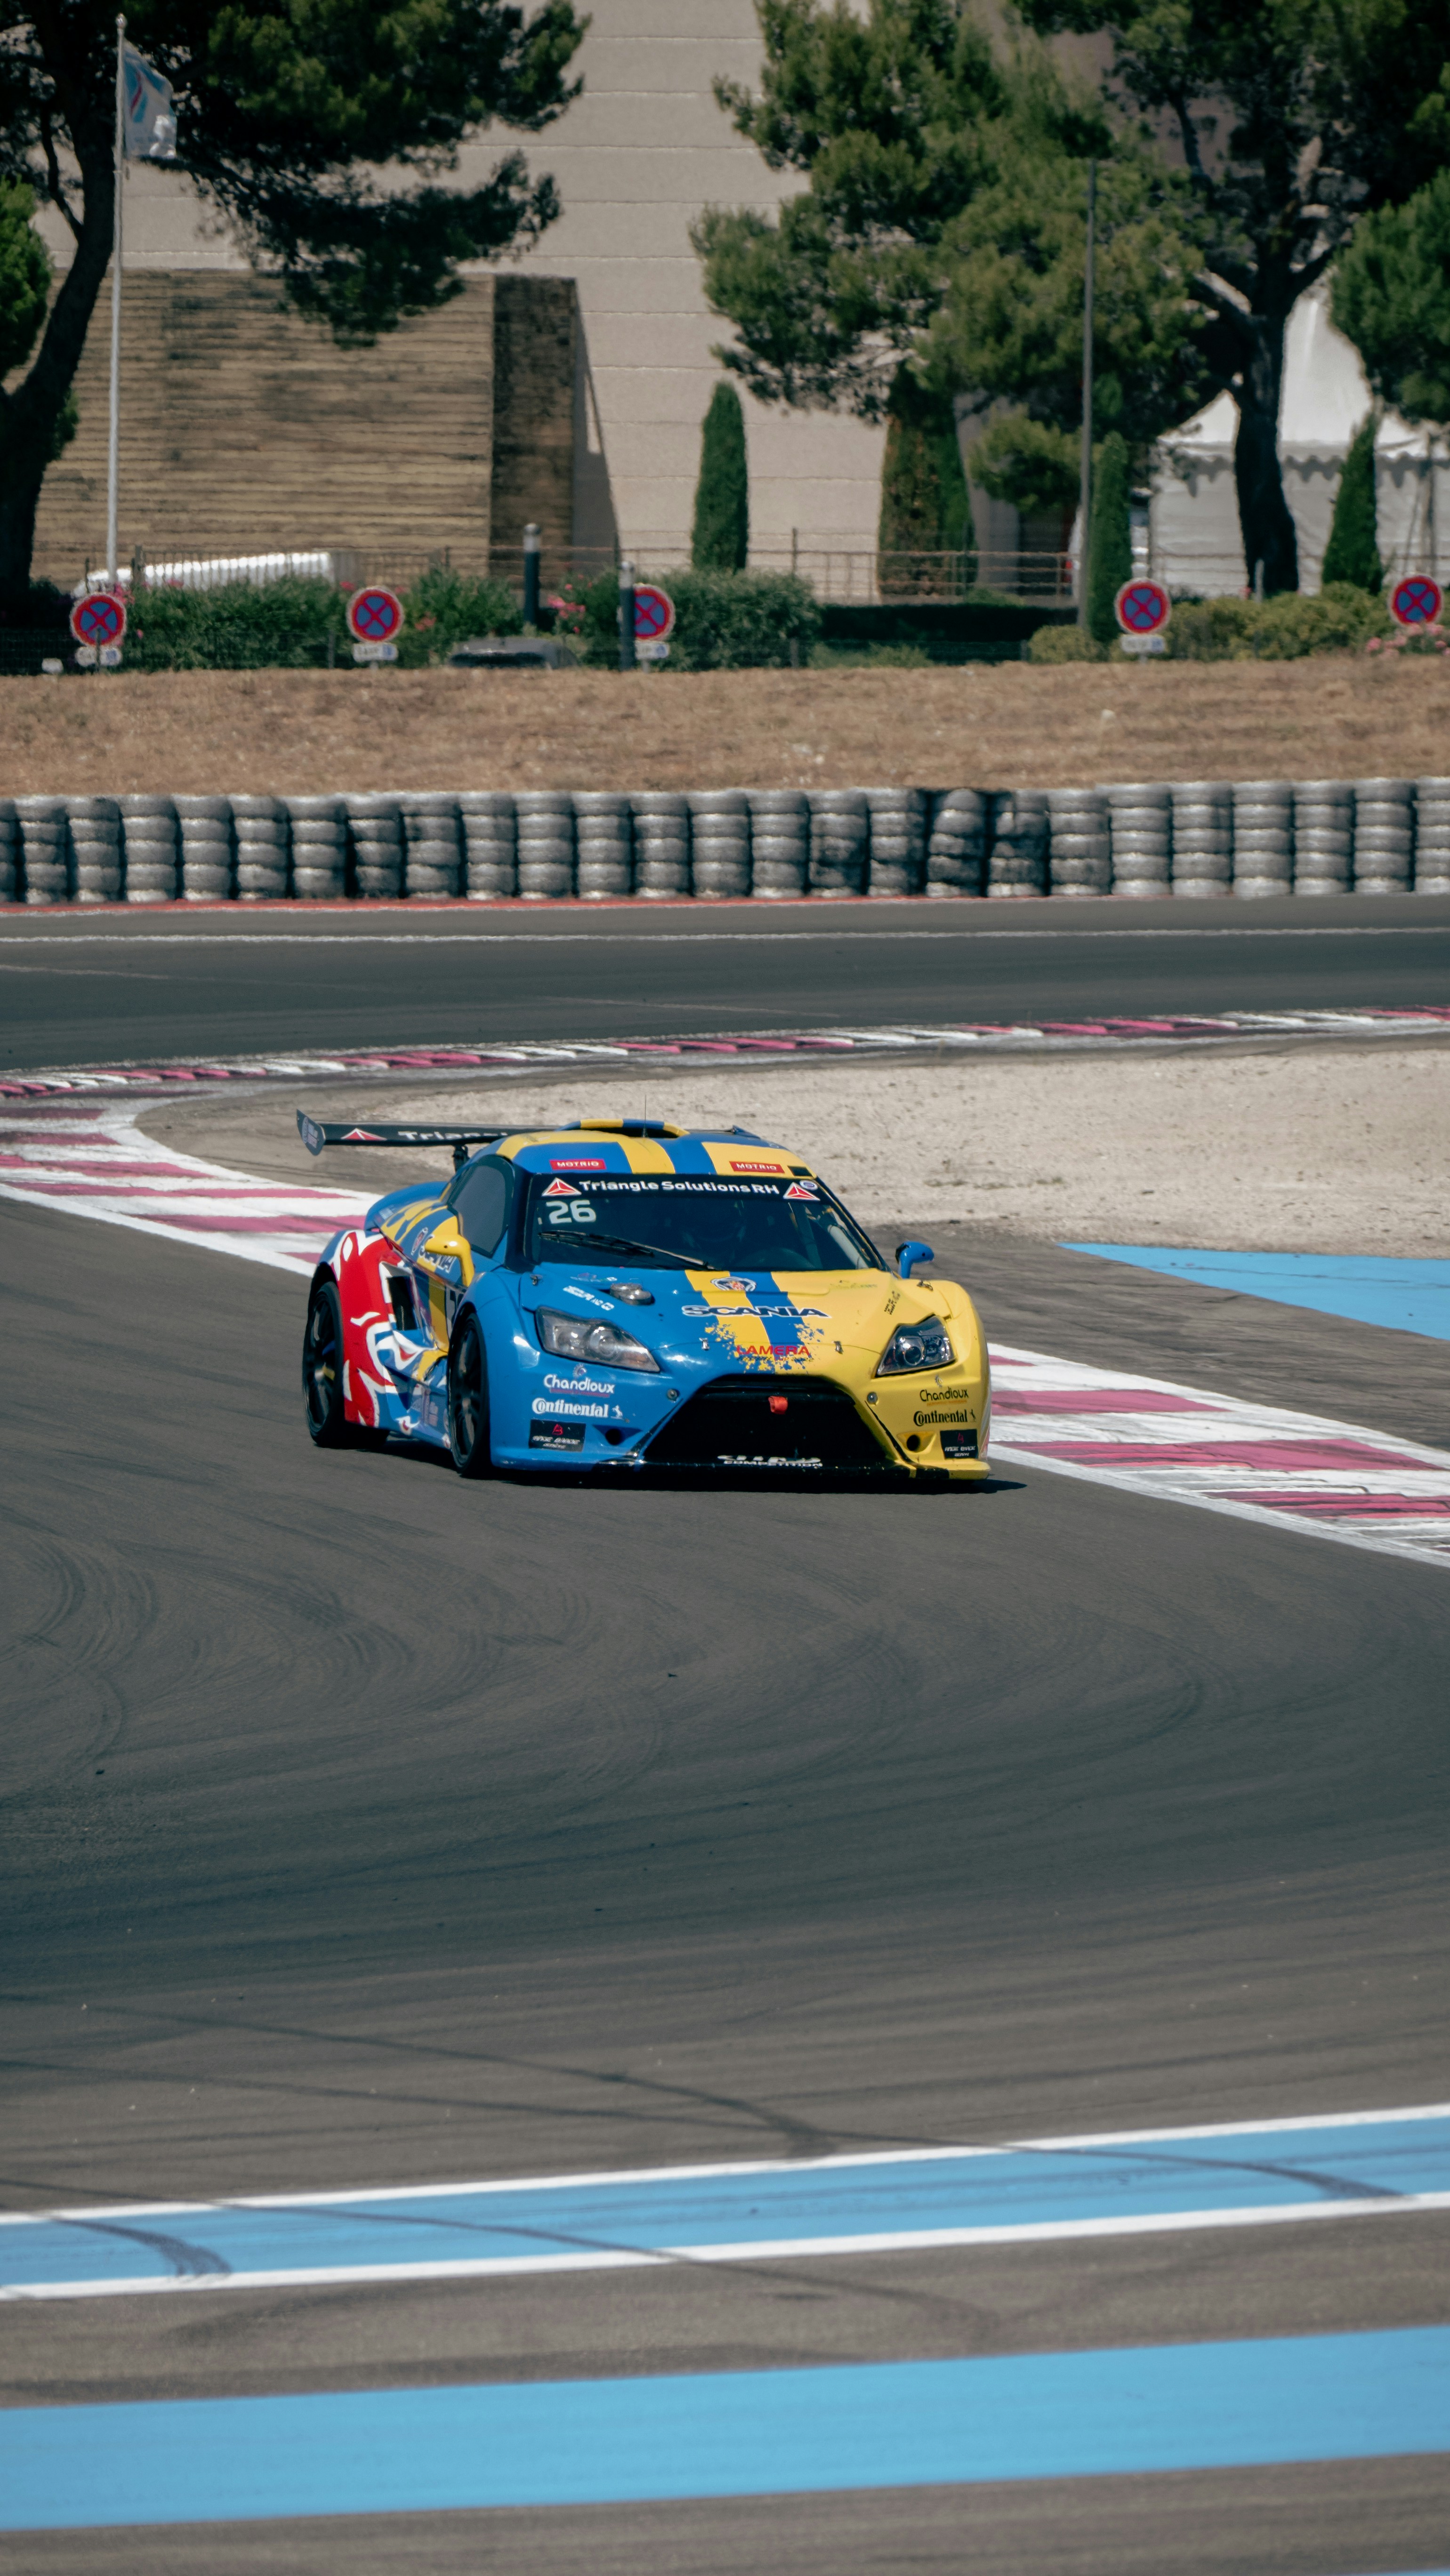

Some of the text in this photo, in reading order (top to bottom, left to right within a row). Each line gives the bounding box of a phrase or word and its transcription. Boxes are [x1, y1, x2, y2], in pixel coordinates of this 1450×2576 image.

[736, 1162, 777, 1171] MOTRIO
[579, 1180, 780, 1194] Triangle Solutions RH
[546, 1199, 596, 1224] 26
[681, 1305, 832, 1319] SCANIA
[736, 1344, 812, 1356] LAMERA
[543, 1374, 615, 1393] Chandioux
[919, 1386, 968, 1401] Chandioux
[532, 1398, 608, 1417] Continental
[914, 1409, 967, 1426] Continental
